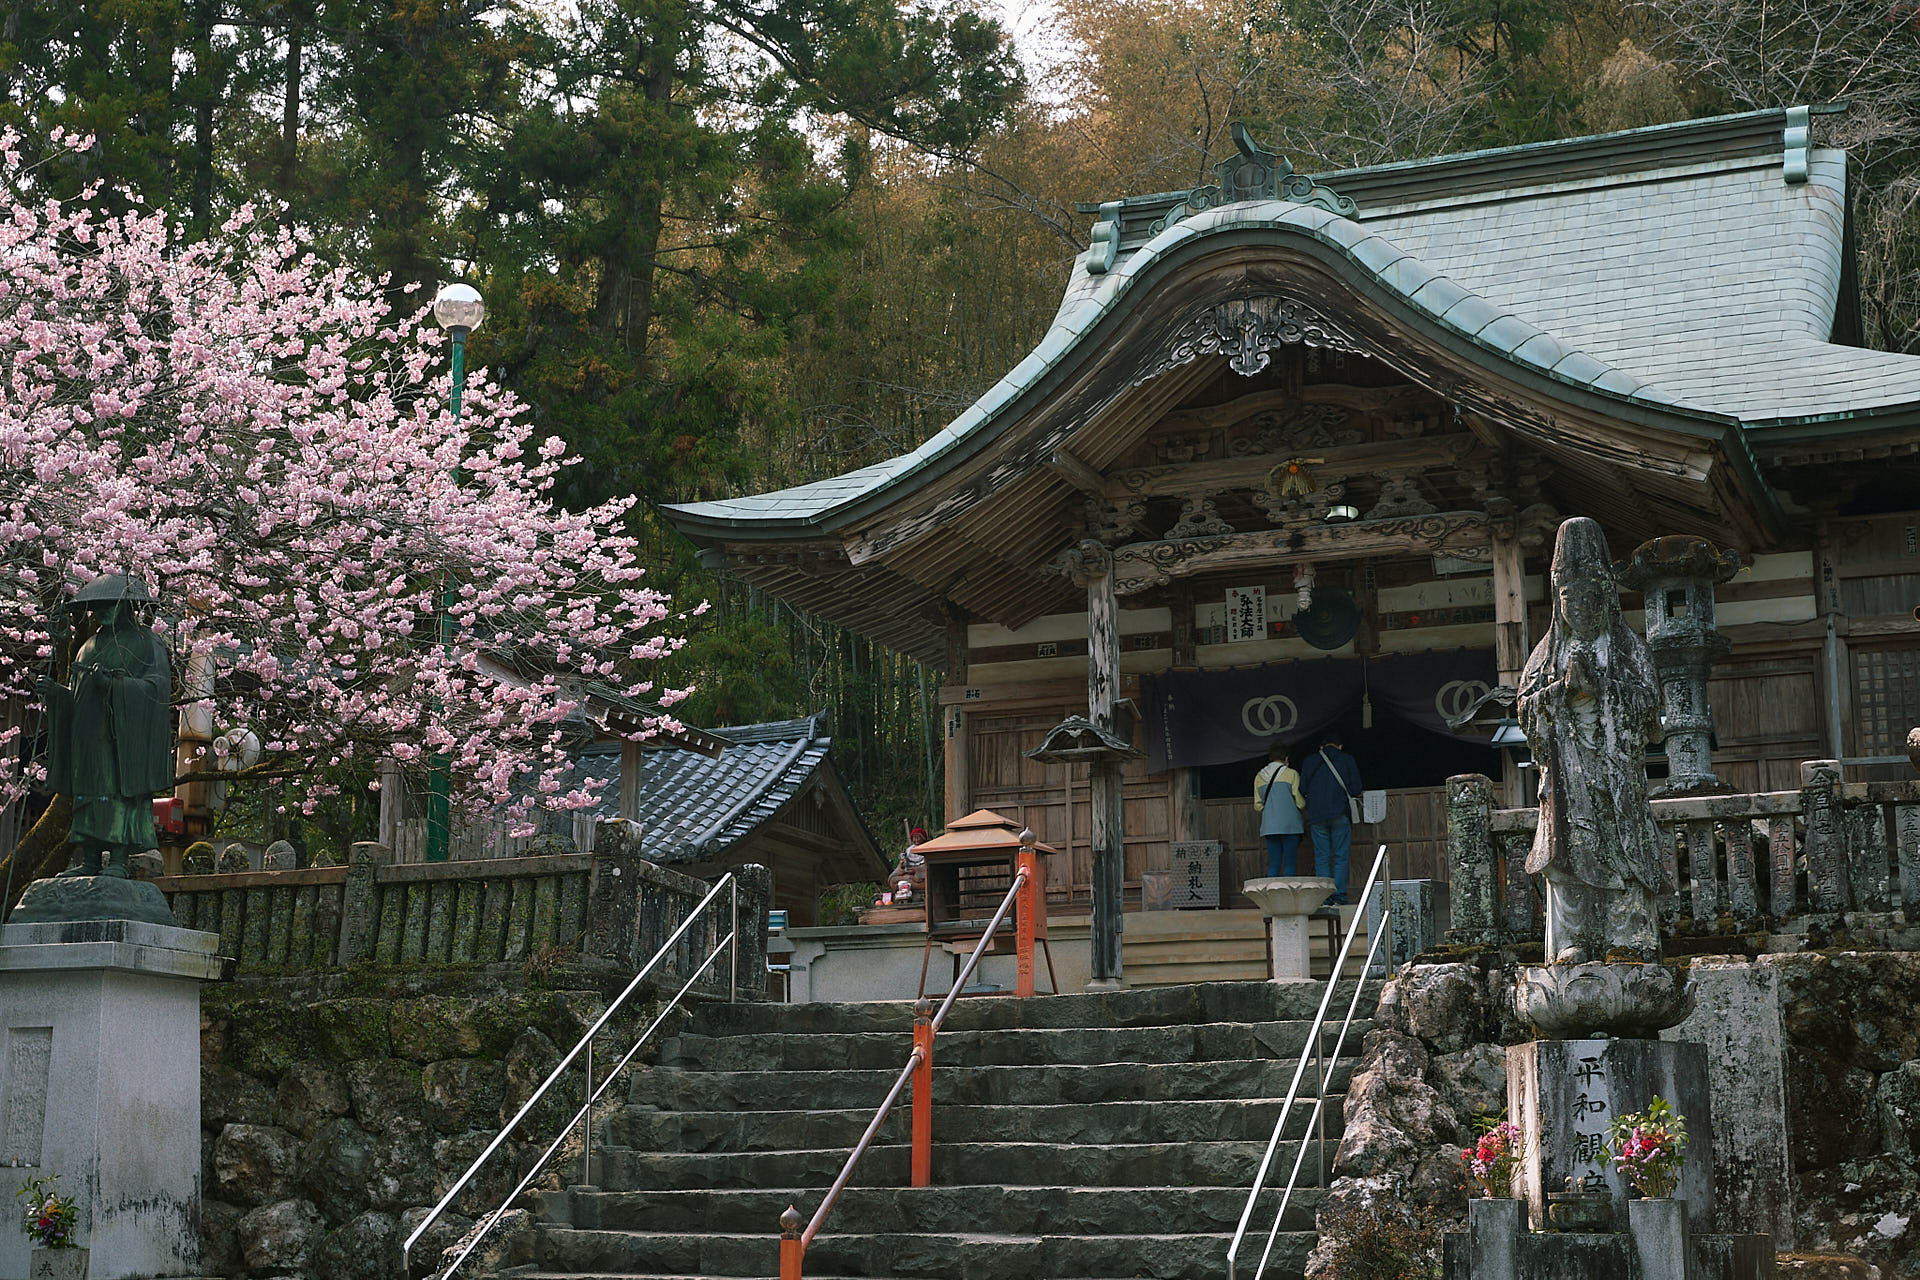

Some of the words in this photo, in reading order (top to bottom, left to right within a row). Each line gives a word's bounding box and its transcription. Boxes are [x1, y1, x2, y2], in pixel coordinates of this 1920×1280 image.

[1240, 594, 1256, 640] 弘法大師
[1188, 861, 1203, 901] 納札入
